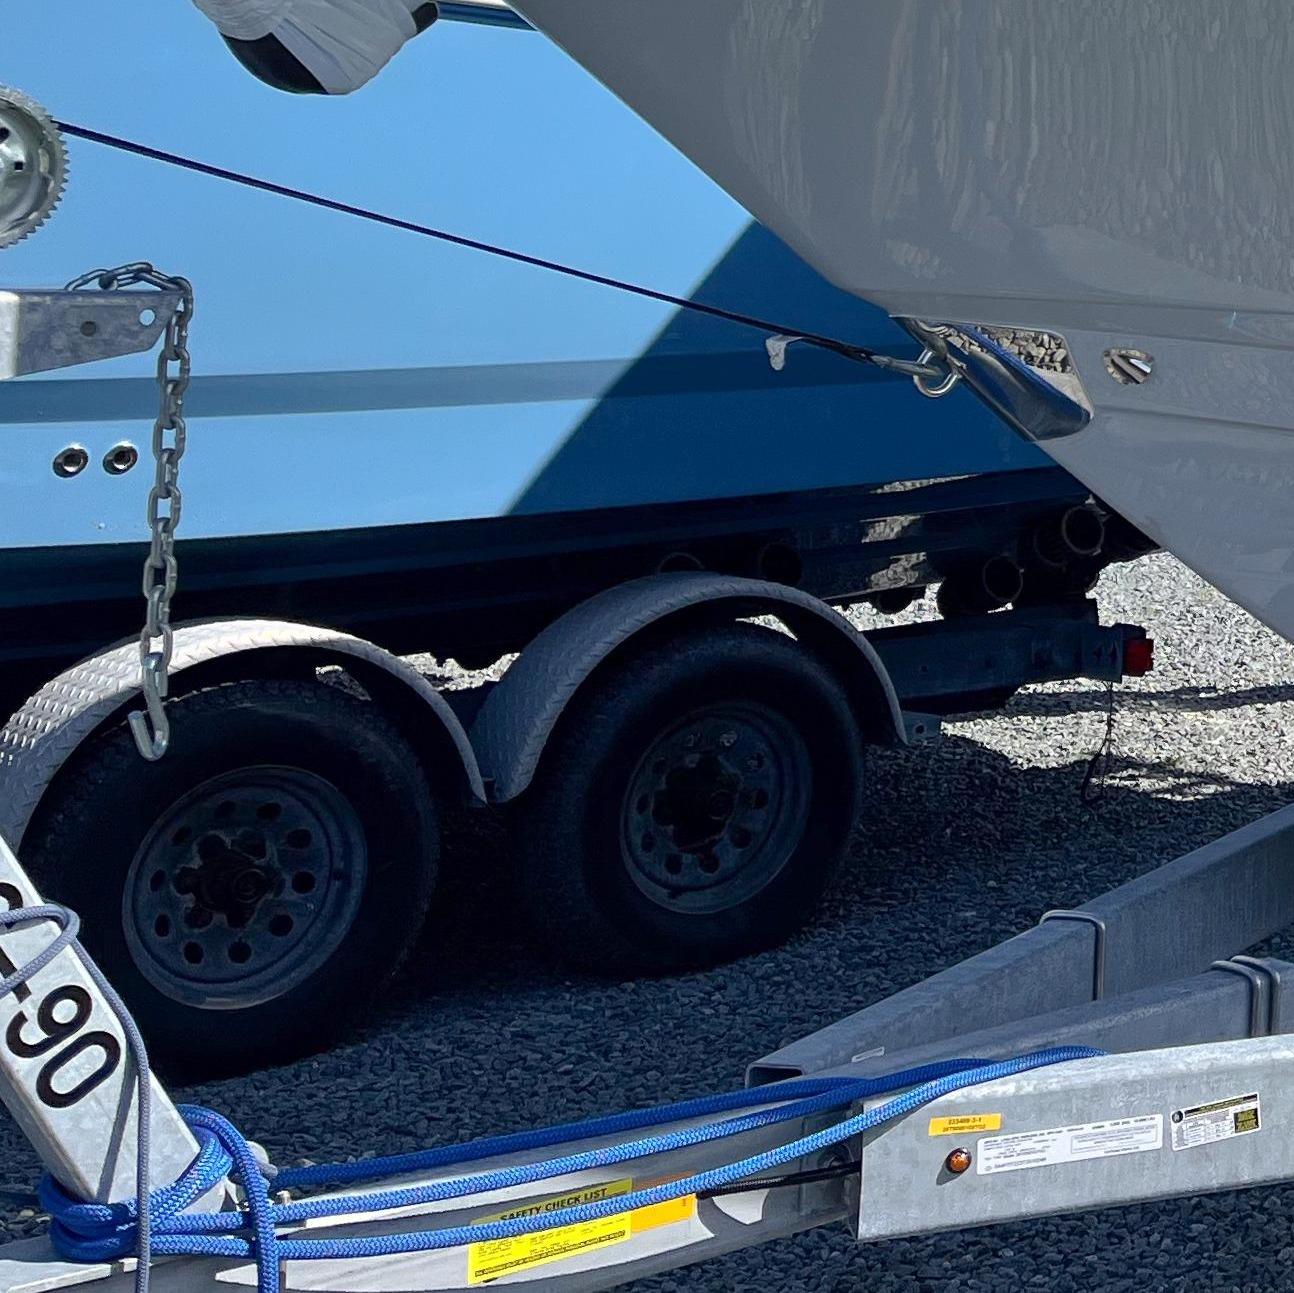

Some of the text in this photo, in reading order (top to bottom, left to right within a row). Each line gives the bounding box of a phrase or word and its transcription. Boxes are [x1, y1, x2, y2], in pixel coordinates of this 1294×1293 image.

[500, 1188, 608, 1221] SAFETY CHECK LIST
